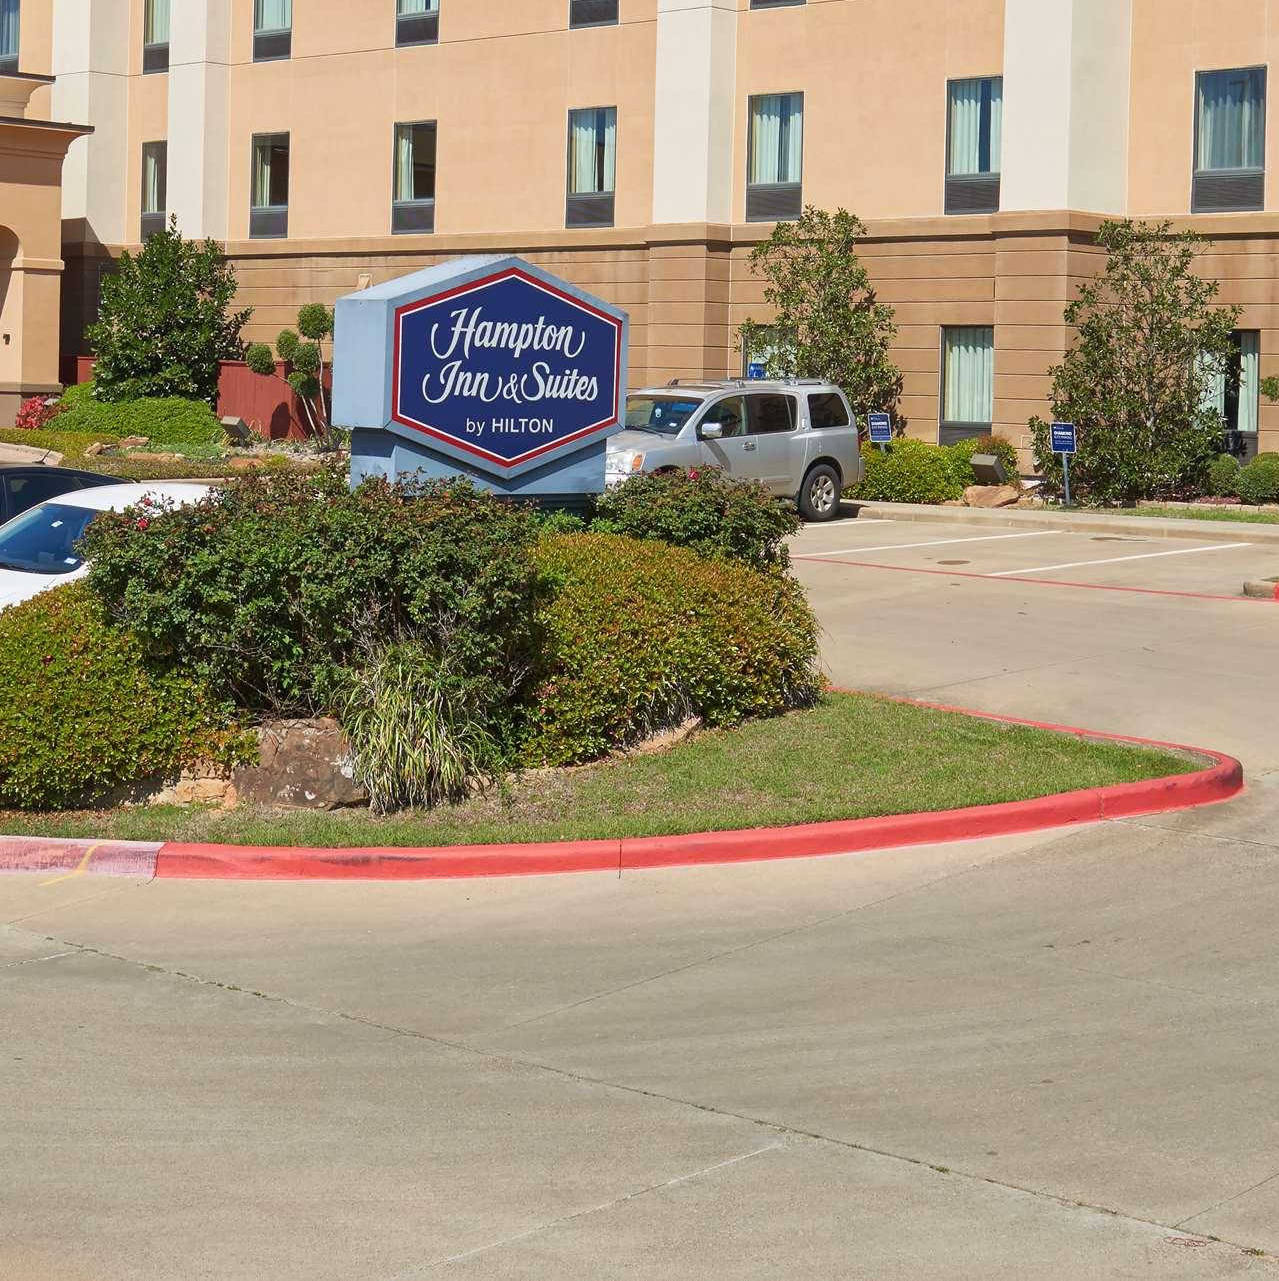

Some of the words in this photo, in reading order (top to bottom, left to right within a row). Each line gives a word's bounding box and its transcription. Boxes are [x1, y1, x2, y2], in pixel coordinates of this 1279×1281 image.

[431, 307, 586, 360] Hampton
[422, 360, 503, 403] Inn
[503, 374, 523, 404] &
[521, 362, 599, 402] Suites
[466, 418, 485, 436] by
[492, 418, 554, 434] HILTON
